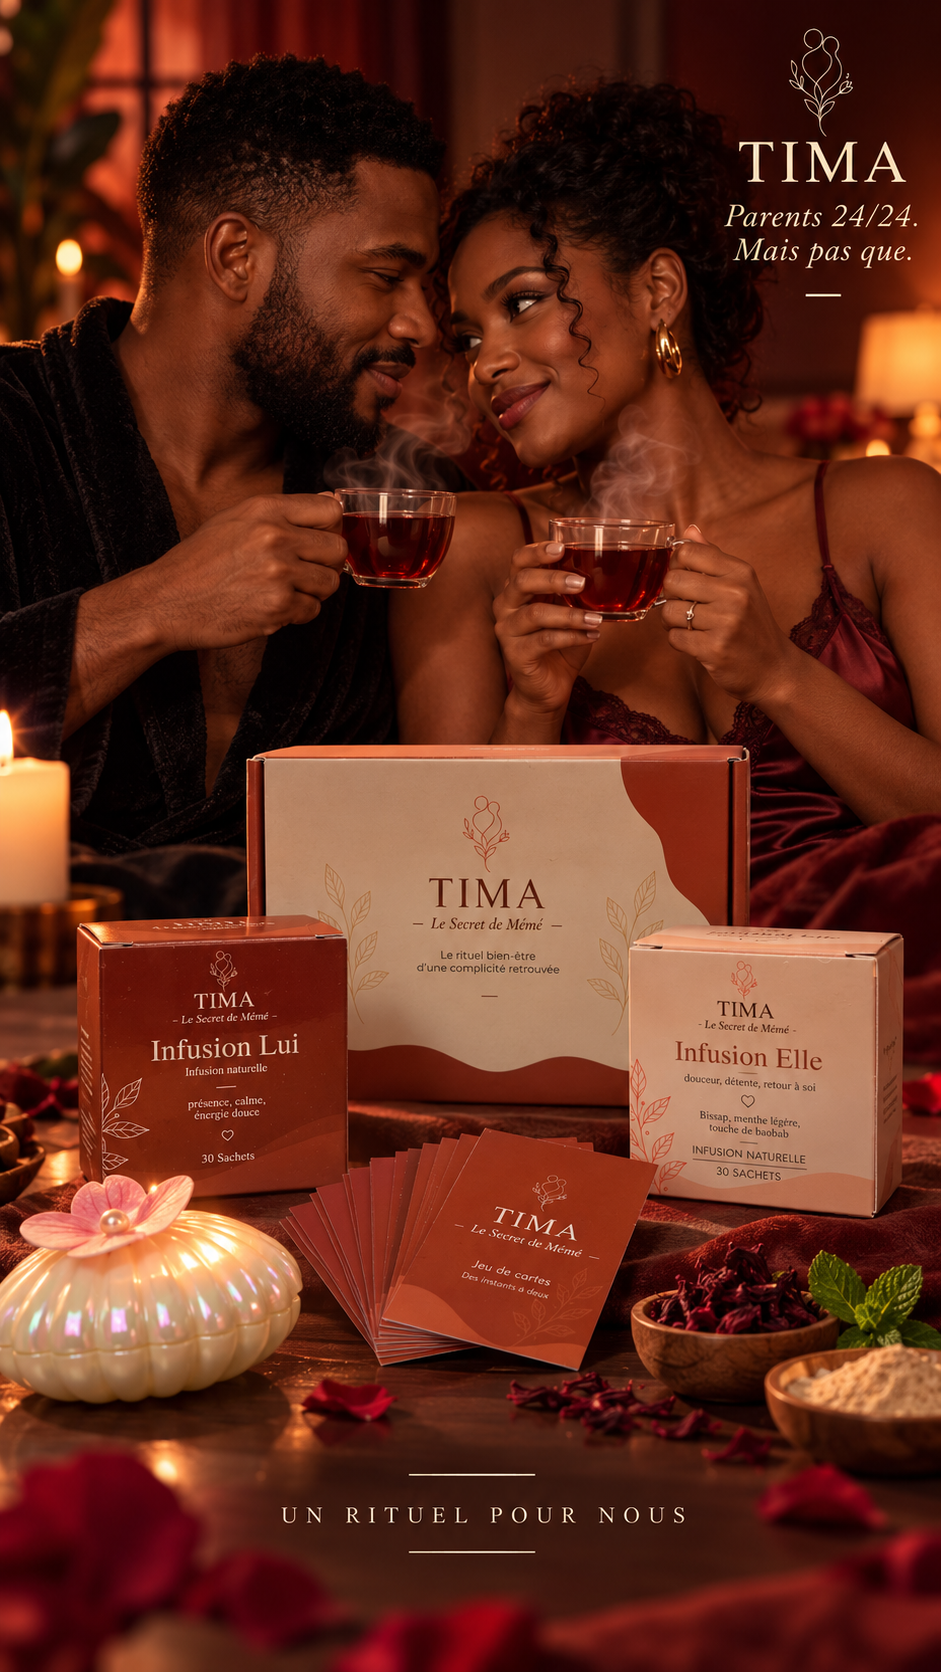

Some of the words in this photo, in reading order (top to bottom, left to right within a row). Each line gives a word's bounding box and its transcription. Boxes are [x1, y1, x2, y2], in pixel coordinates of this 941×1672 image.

[428, 878, 545, 909] TIMA
[431, 917, 446, 930] Le
[449, 917, 485, 930] Secret
[488, 917, 503, 930] de
[506, 918, 544, 931] Mémé
[440, 950, 453, 960] Le
[456, 950, 484, 960] rituel
[416, 963, 447, 972] d'une
[450, 963, 506, 974] complicité
[509, 964, 560, 974] retrouvée
[193, 991, 255, 1010] TIMA
[717, 1000, 775, 1019] TIMA
[181, 1015, 194, 1024] Le
[195, 1014, 224, 1024] Secret
[226, 1013, 238, 1022] de
[240, 1012, 269, 1021] Mémé
[704, 1020, 716, 1029] Le
[718, 1021, 745, 1031] Secret
[747, 1023, 758, 1032] de
[761, 1024, 790, 1034] Mémé
[151, 1037, 252, 1062] Infusion
[259, 1033, 300, 1056] Lui
[674, 1040, 768, 1068] Infusion
[776, 1047, 823, 1071] Elle
[185, 1066, 224, 1077] Infusion
[226, 1063, 268, 1074] naturelle
[684, 1074, 723, 1086] douceur,
[724, 1077, 761, 1090] détente,
[764, 1080, 792, 1090] retour
[794, 1081, 800, 1091] à
[802, 1082, 816, 1092] soi
[187, 1098, 233, 1111] présence,
[234, 1096, 266, 1107] calme,
[194, 1109, 230, 1121] énergie
[231, 1107, 260, 1118] douce
[700, 1110, 731, 1123] Bissap,
[734, 1115, 768, 1125] menthe
[709, 1124, 739, 1134] touche
[741, 1126, 753, 1135] de
[755, 1127, 789, 1138] baobab
[201, 1153, 215, 1164] 30
[217, 1151, 255, 1164] Sachets
[692, 1145, 743, 1159] INFUSION
[746, 1149, 806, 1165] NATURELLE
[716, 1166, 730, 1177] 30
[732, 1167, 782, 1182] SACHETS
[493, 1206, 578, 1242] TIMA
[470, 1224, 486, 1235] Le
[489, 1229, 526, 1245] Secret
[527, 1238, 543, 1248] de
[544, 1242, 583, 1258] Mémé
[471, 1260, 493, 1272] Jeu
[496, 1266, 511, 1276] de
[514, 1272, 551, 1287] cartes
[461, 1271, 478, 1282] Des
[480, 1276, 516, 1291] instants
[526, 1288, 549, 1299] deux
